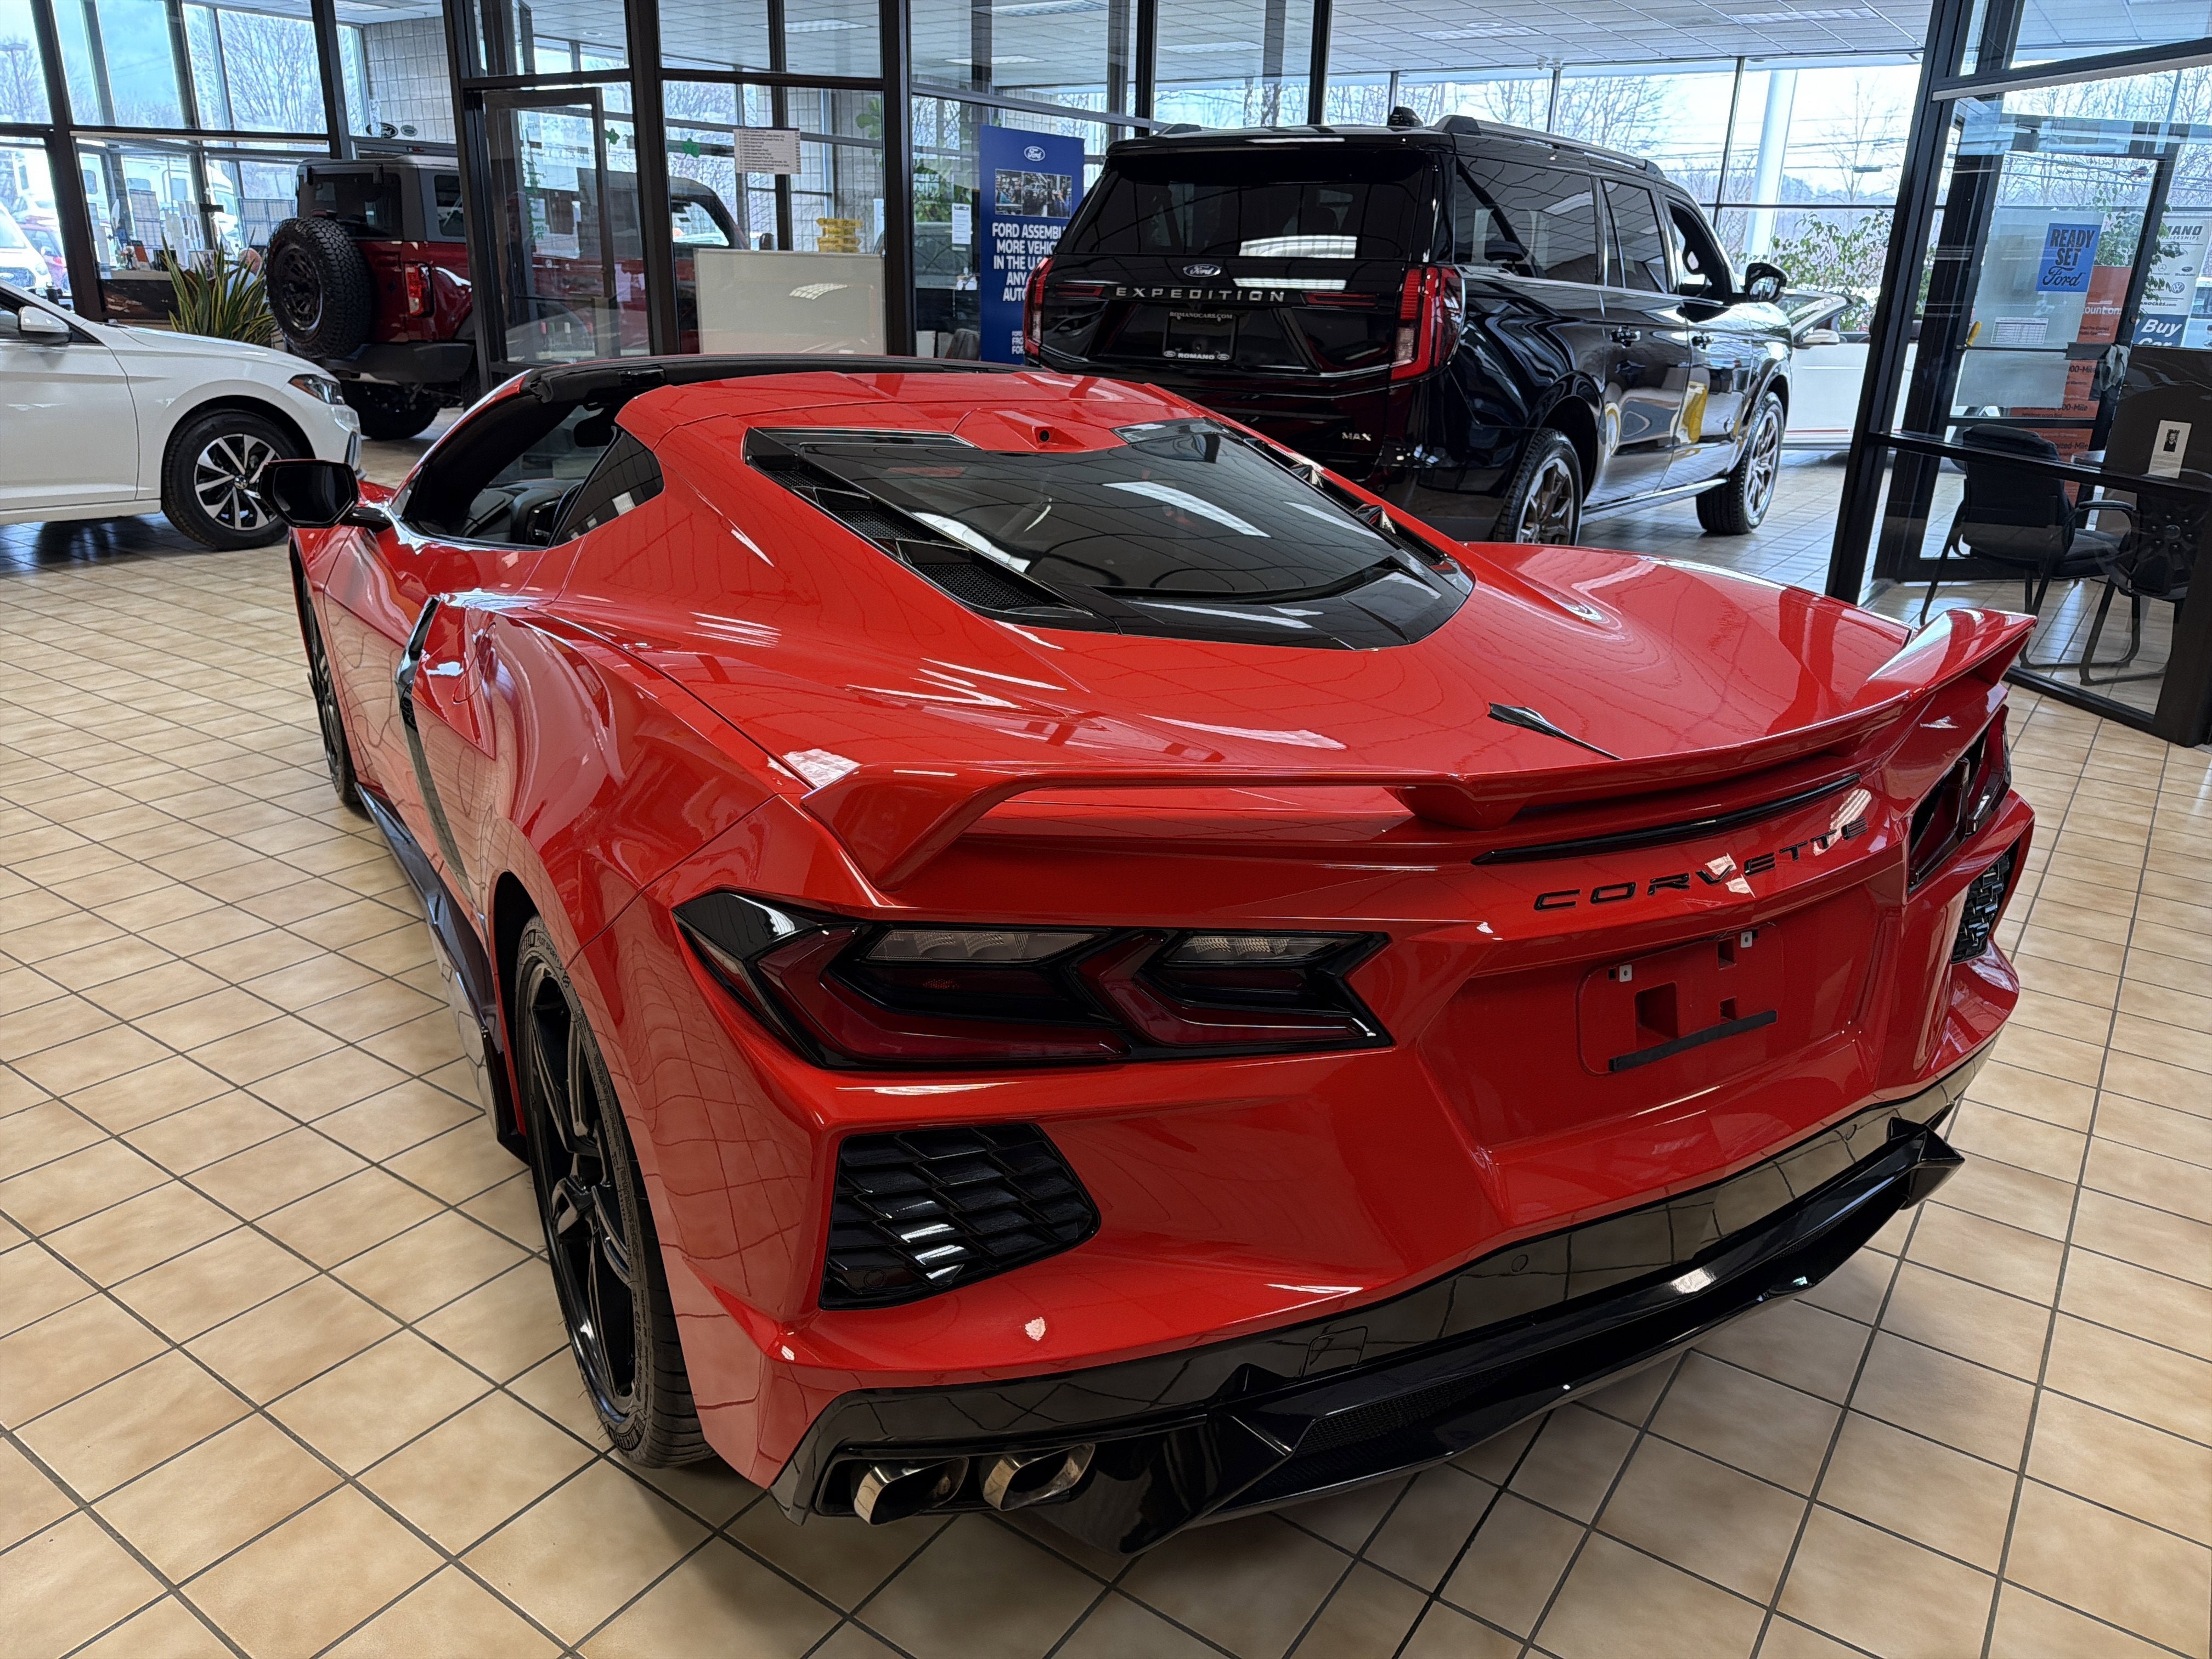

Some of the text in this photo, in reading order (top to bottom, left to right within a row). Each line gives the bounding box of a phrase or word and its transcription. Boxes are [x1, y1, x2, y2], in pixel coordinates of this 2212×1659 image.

[992, 222, 1066, 239] FORD ASSEMBL
[996, 239, 1025, 253] MORE
[2050, 229, 2095, 248] READY
[993, 255, 1005, 269] IN
[1006, 256, 1026, 270] THE
[2055, 248, 2081, 266] SET
[1189, 264, 1214, 275] Ford
[2042, 266, 2086, 286] Ford
[1006, 272, 1028, 285] ANY
[1116, 287, 1284, 302] EXPEDITION
[2084, 307, 2107, 315] ount
[2141, 319, 2182, 337] Buy
[1342, 432, 1372, 441] MAX
[1533, 817, 1868, 911] CORVETTE
